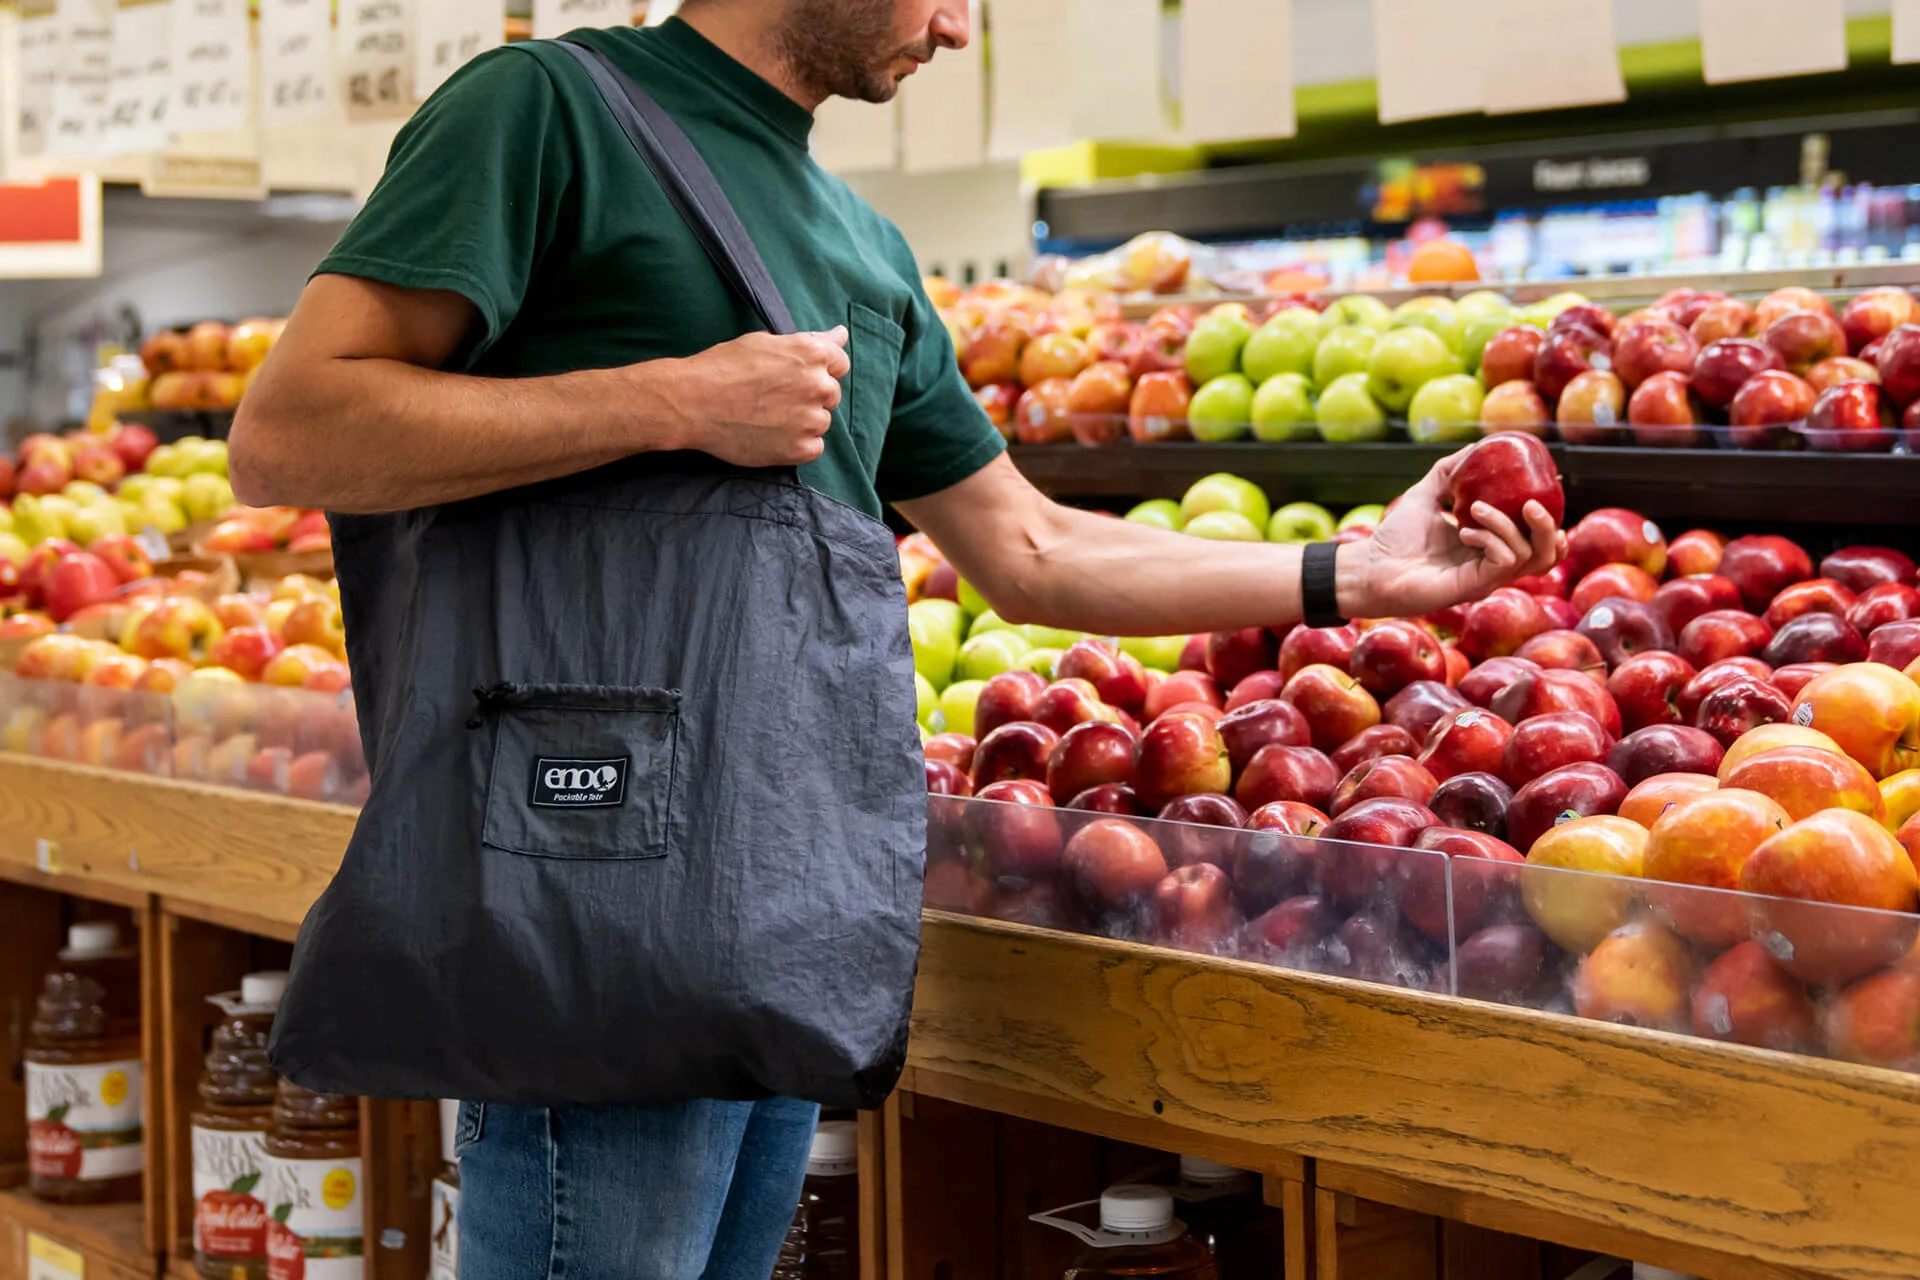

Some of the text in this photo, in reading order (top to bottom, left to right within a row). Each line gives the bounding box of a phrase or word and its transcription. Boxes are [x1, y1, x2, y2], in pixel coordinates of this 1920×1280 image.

[544, 767, 595, 790] eno
[553, 793, 604, 801] Packable Tote
